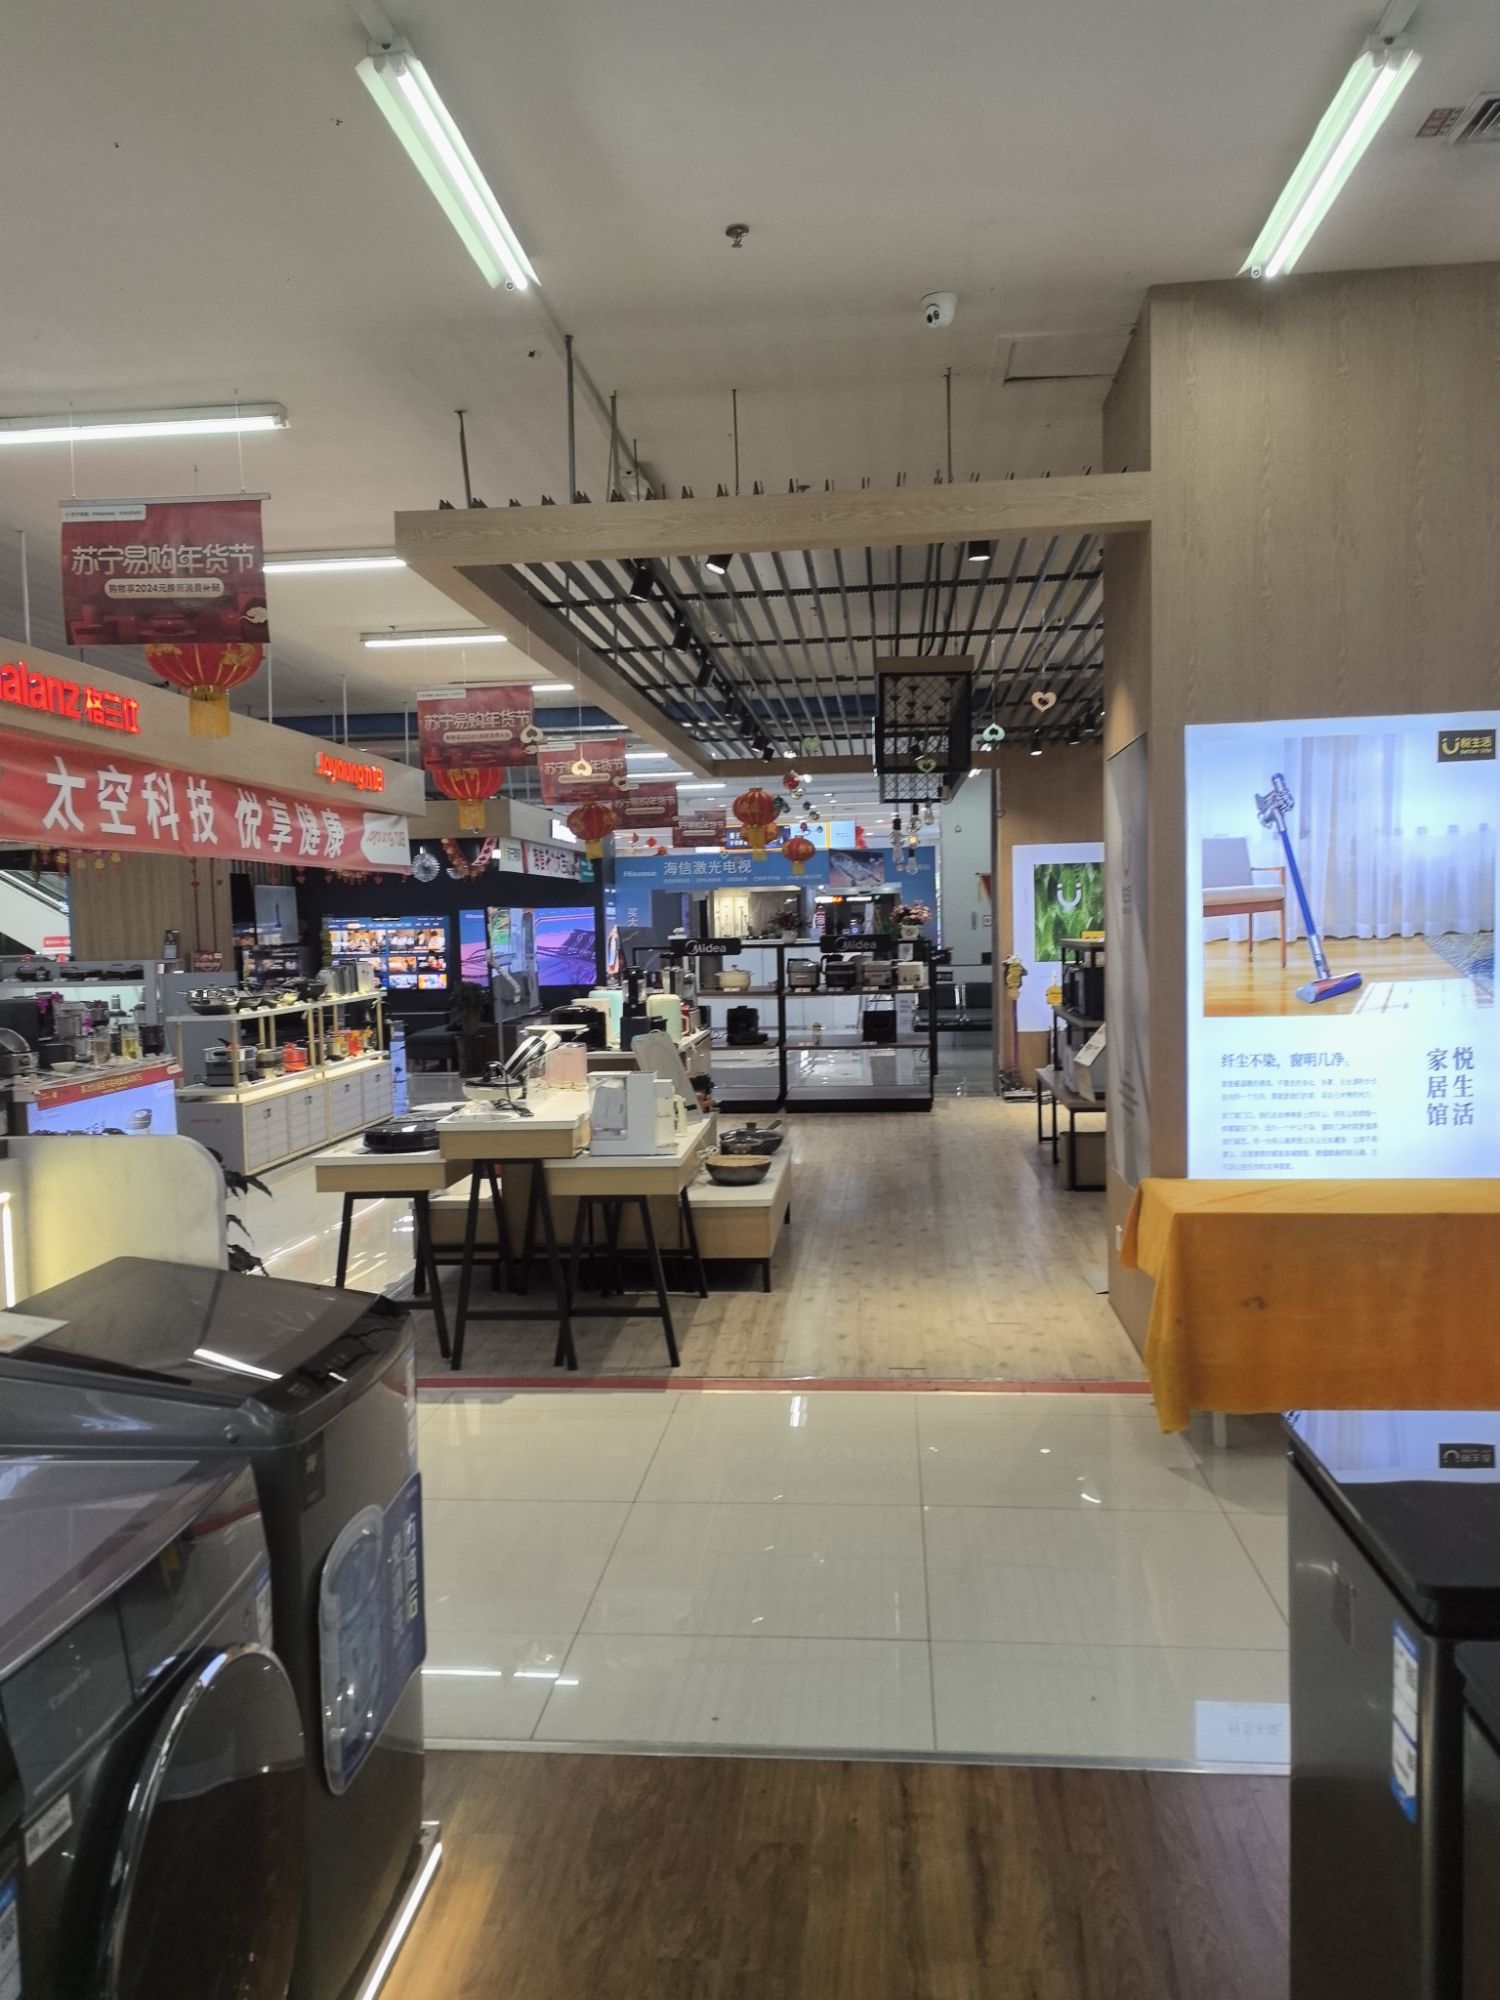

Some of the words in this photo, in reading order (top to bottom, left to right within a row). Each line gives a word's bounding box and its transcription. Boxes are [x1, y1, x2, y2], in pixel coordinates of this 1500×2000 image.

[71, 543, 256, 576] 苏宁易购年货节
[0, 659, 82, 720] alanz
[424, 710, 531, 732] 苏宁易购年货节
[42, 755, 219, 844] 太空科技
[235, 787, 346, 858] 悦享健康
[664, 860, 752, 876] 海信激光电视
